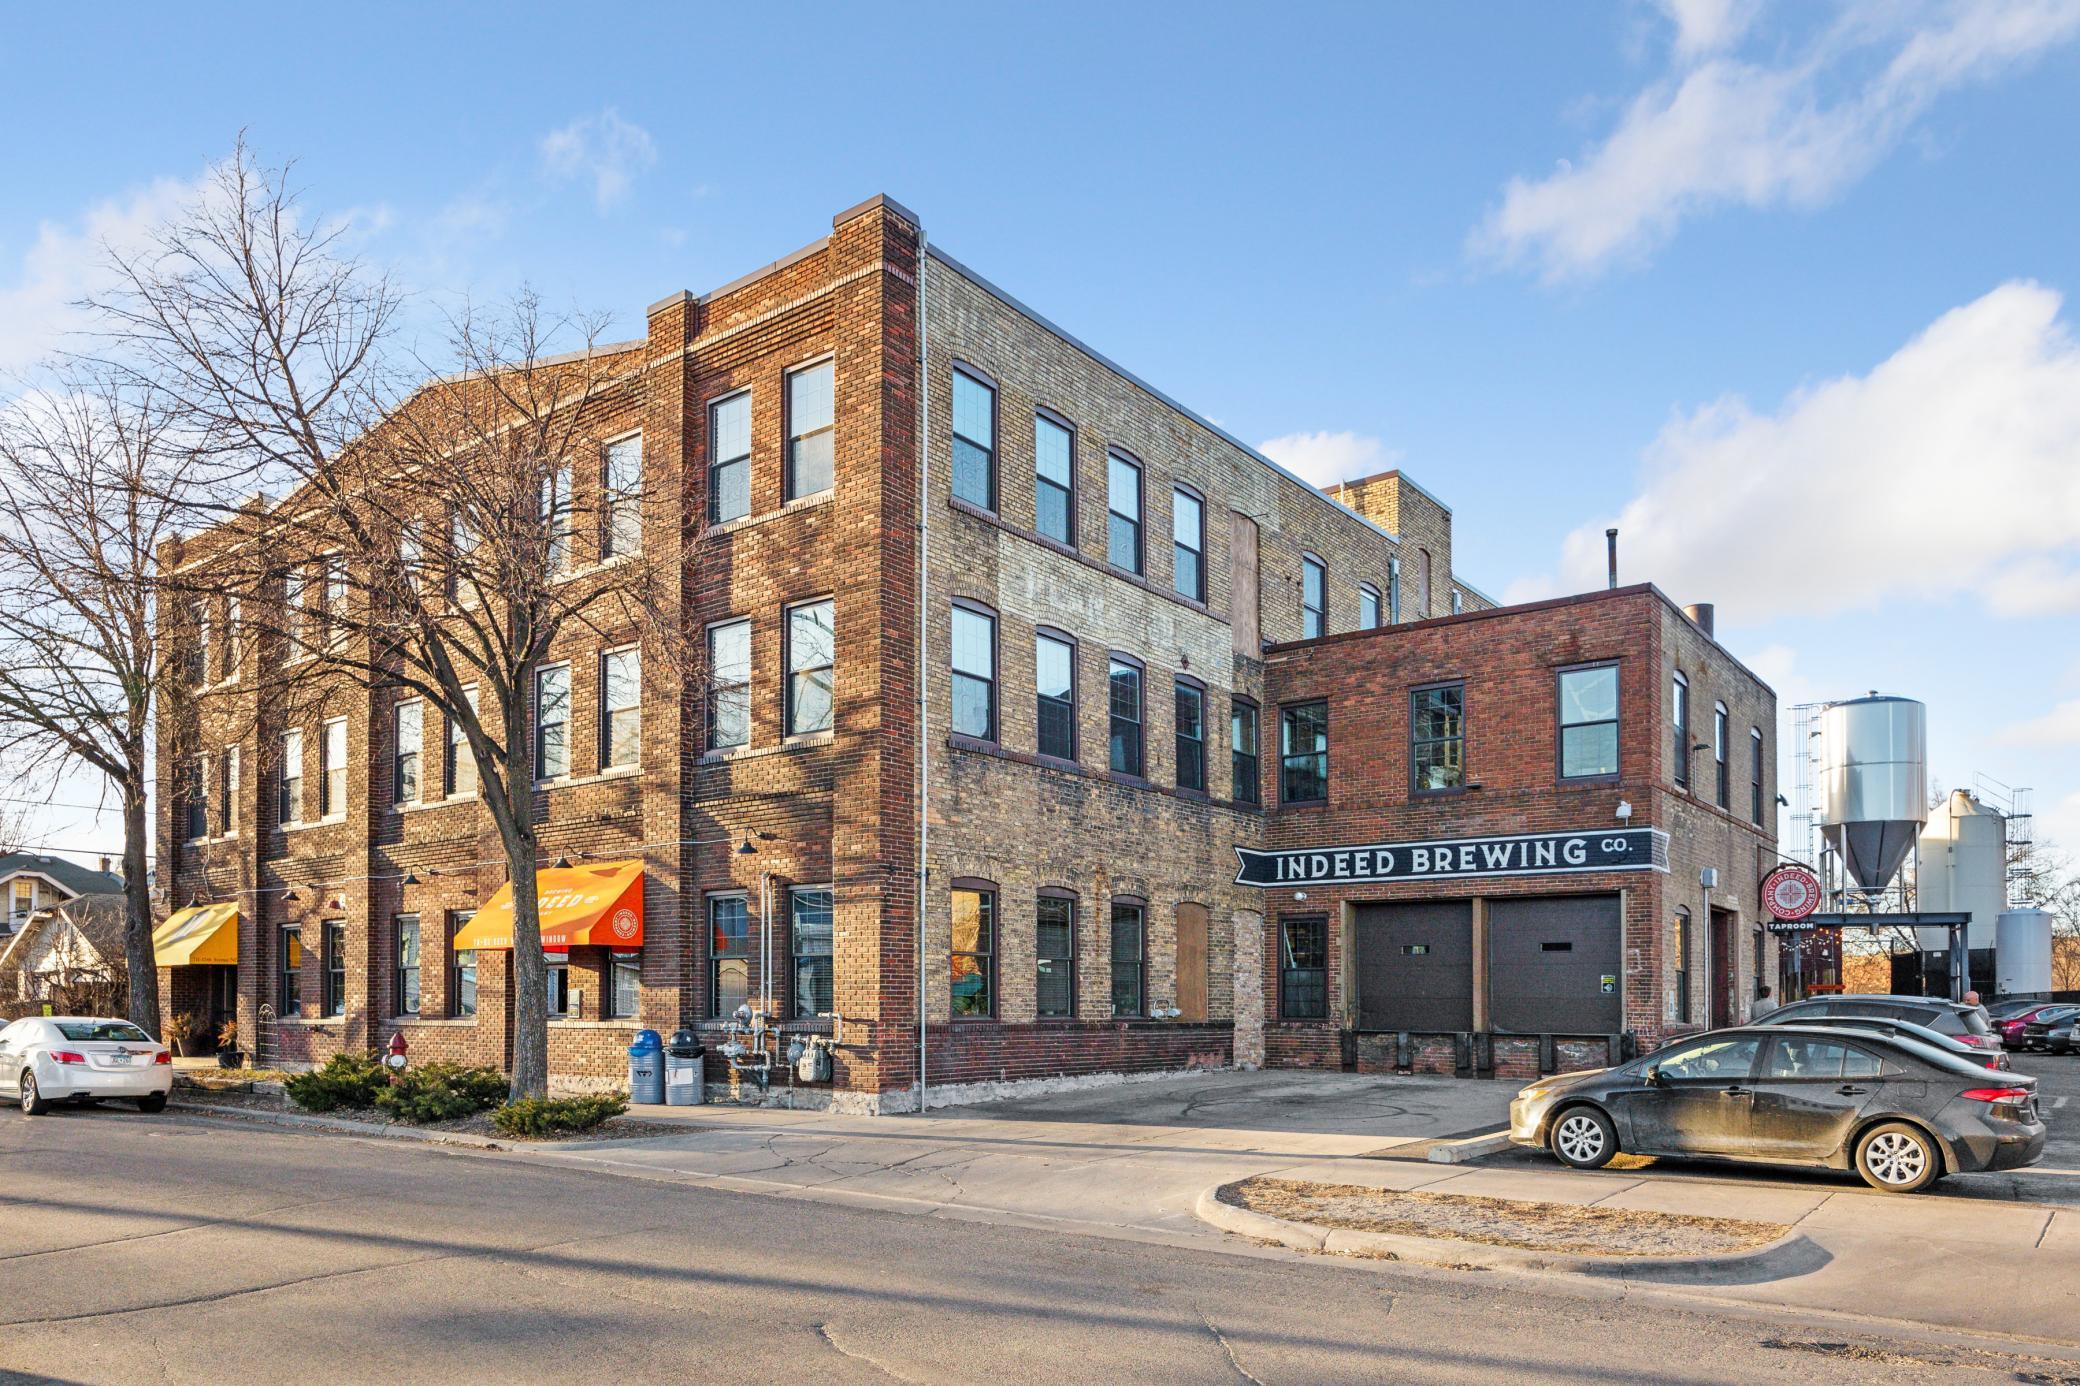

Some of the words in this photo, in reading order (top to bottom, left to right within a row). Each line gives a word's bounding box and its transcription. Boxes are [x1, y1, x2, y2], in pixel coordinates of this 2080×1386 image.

[1276, 850, 1395, 880] INDEED
[1411, 838, 1588, 873] BREWING
[1601, 838, 1633, 852] CO.
[1775, 873, 1807, 884] INDEED
[538, 894, 584, 909] DEED
[1767, 885, 1790, 916] COMPANY
[1795, 882, 1815, 915] BREWING
